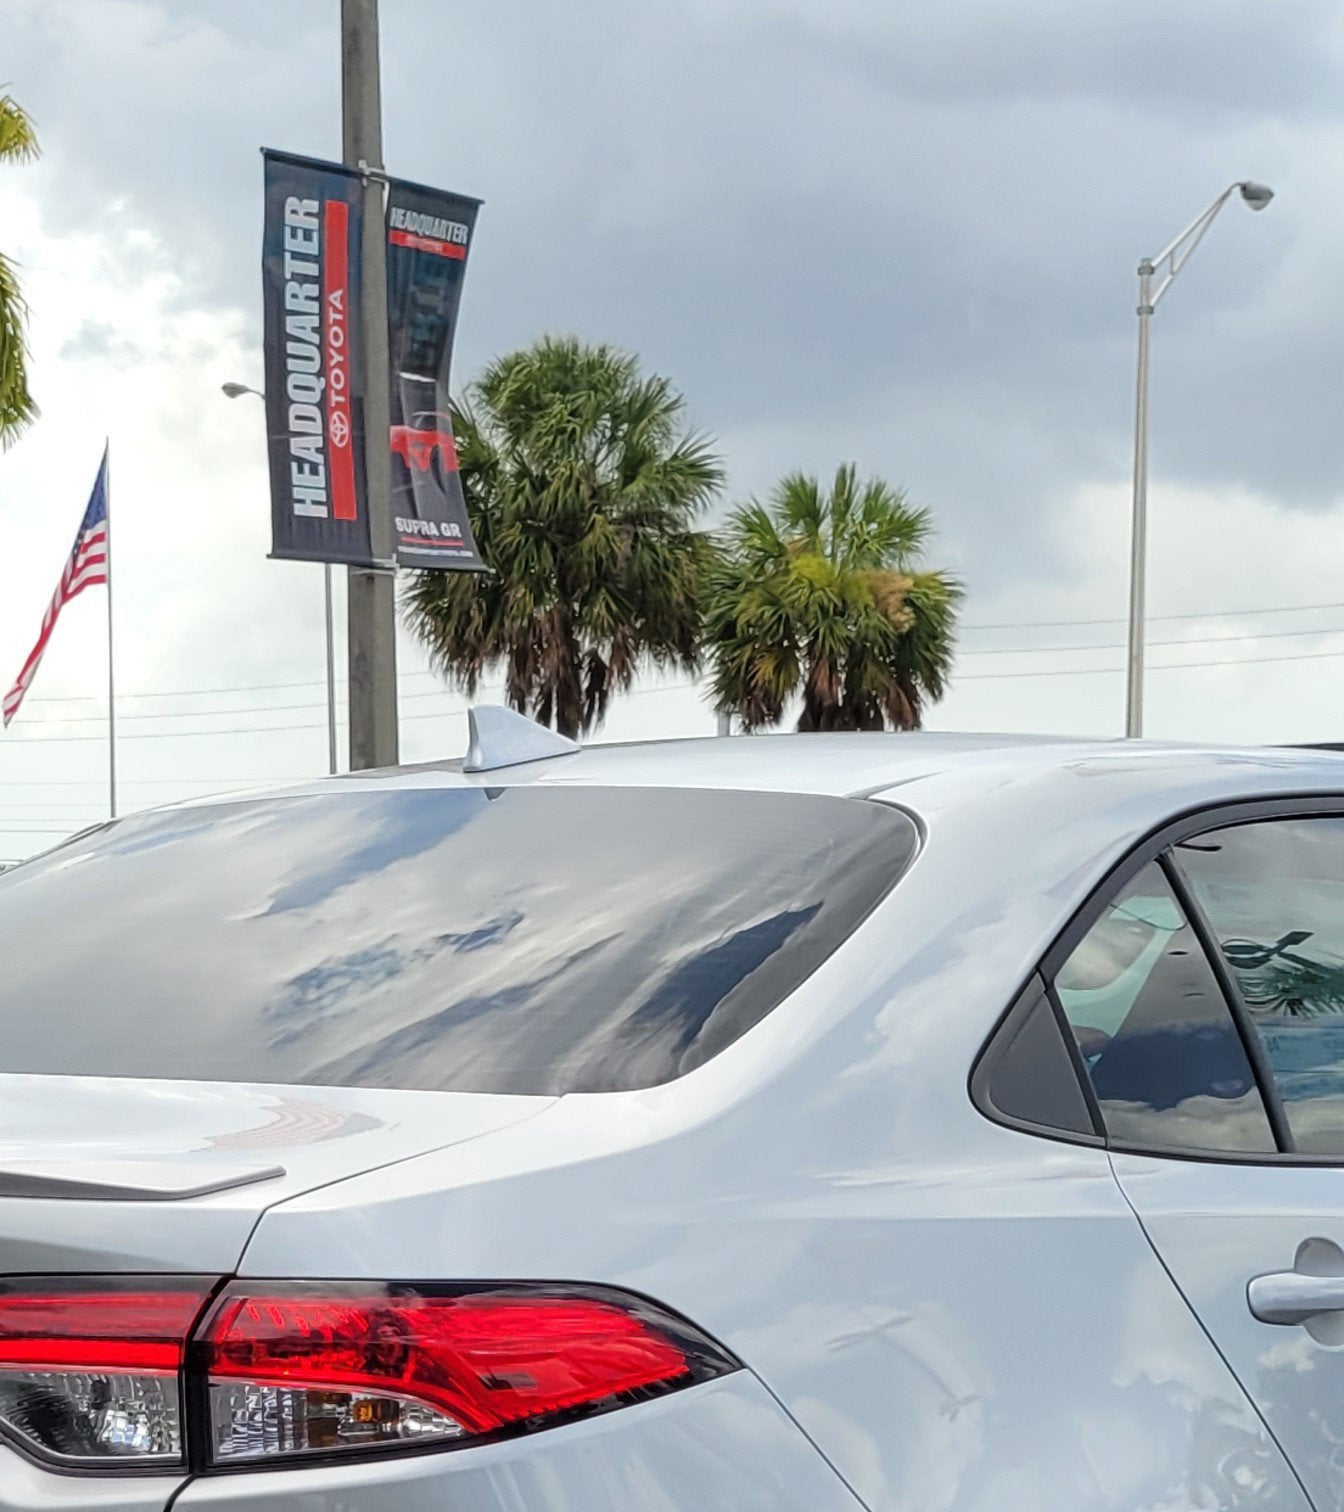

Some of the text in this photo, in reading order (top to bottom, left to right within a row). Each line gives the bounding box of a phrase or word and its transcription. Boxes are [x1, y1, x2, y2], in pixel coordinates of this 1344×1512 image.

[284, 196, 329, 519] HEADQUARTER
[329, 289, 346, 407] TOYOTA
[394, 516, 462, 538] SUPRA GR
